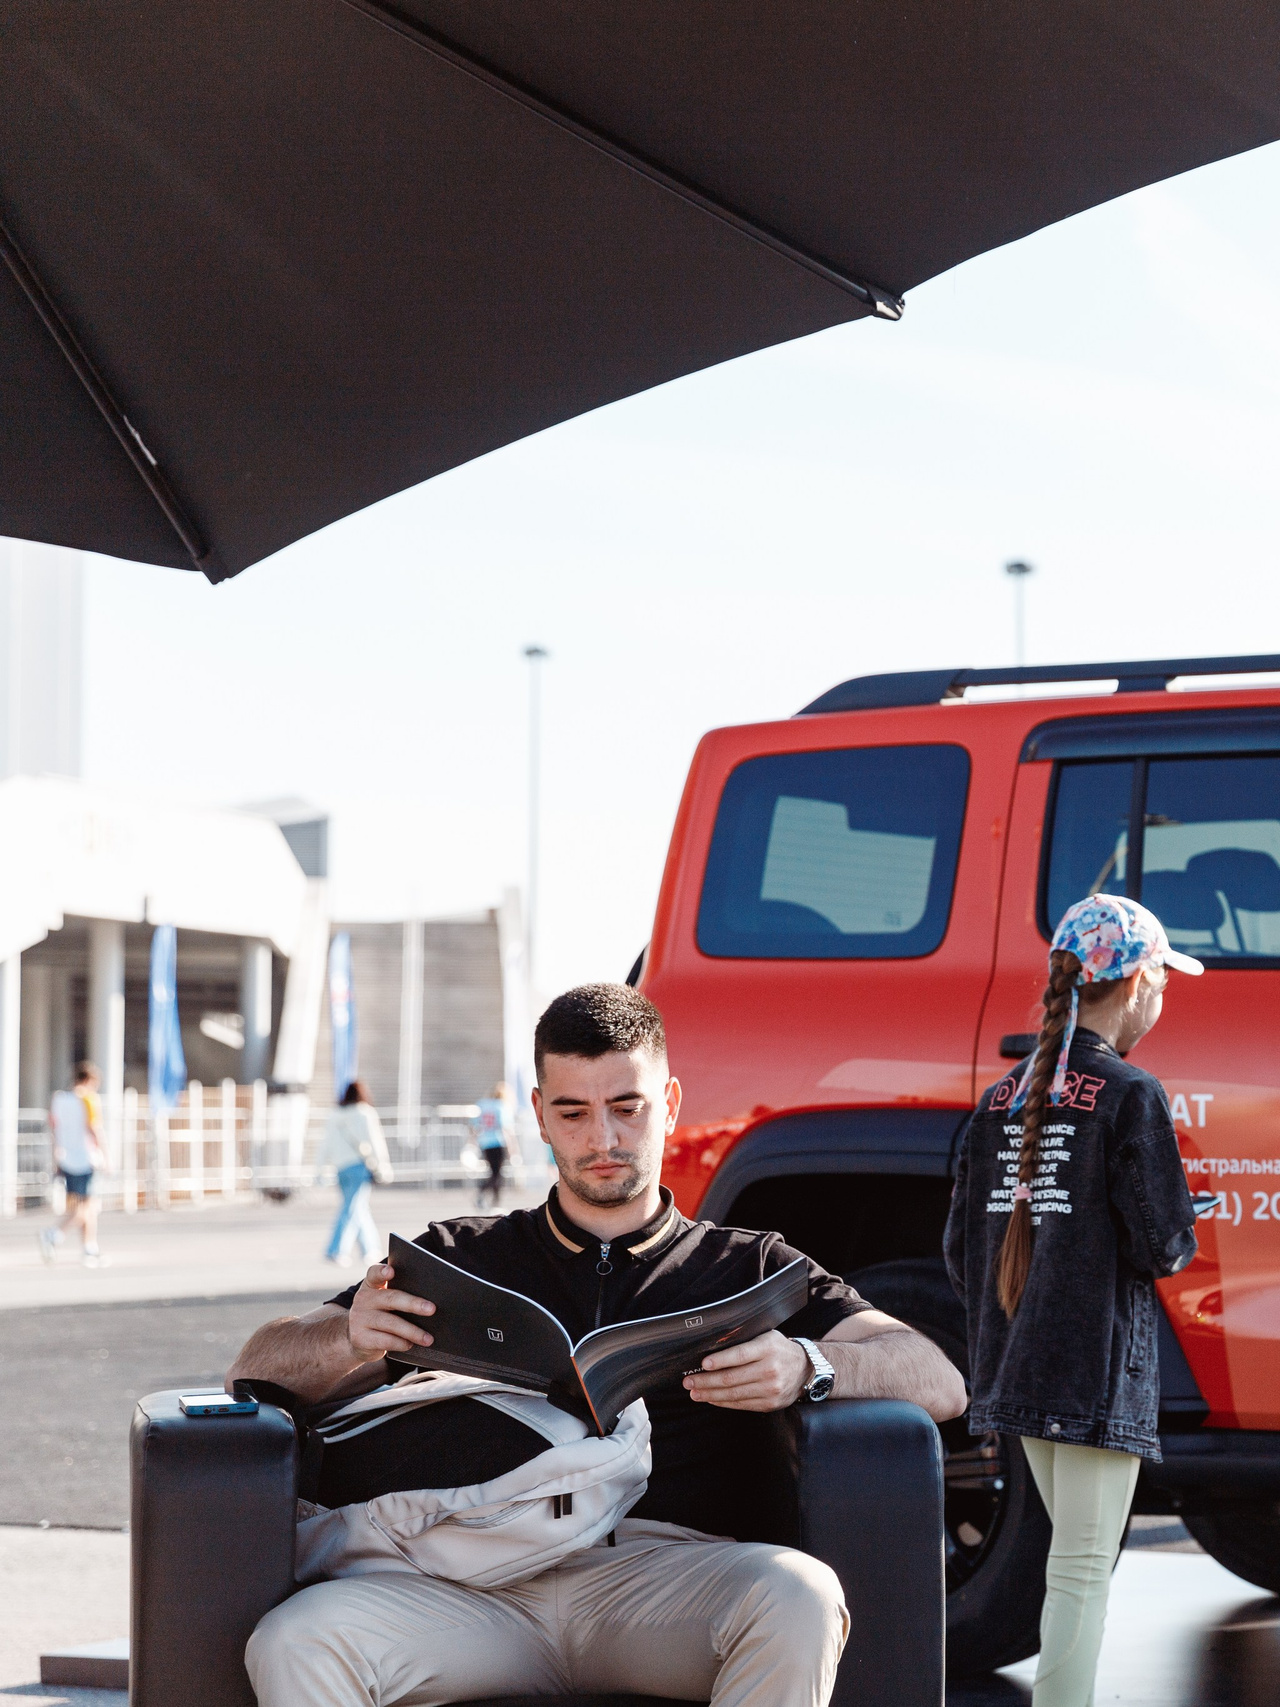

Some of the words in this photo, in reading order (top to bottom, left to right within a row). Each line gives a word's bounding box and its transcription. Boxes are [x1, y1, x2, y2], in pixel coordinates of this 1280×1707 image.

[988, 1071, 1107, 1112] DCE
[1171, 1093, 1214, 1128] АТ
[1009, 1137, 1024, 1148] YO
[997, 1150, 1022, 1161] HAV
[682, 1366, 705, 1376] TAN
